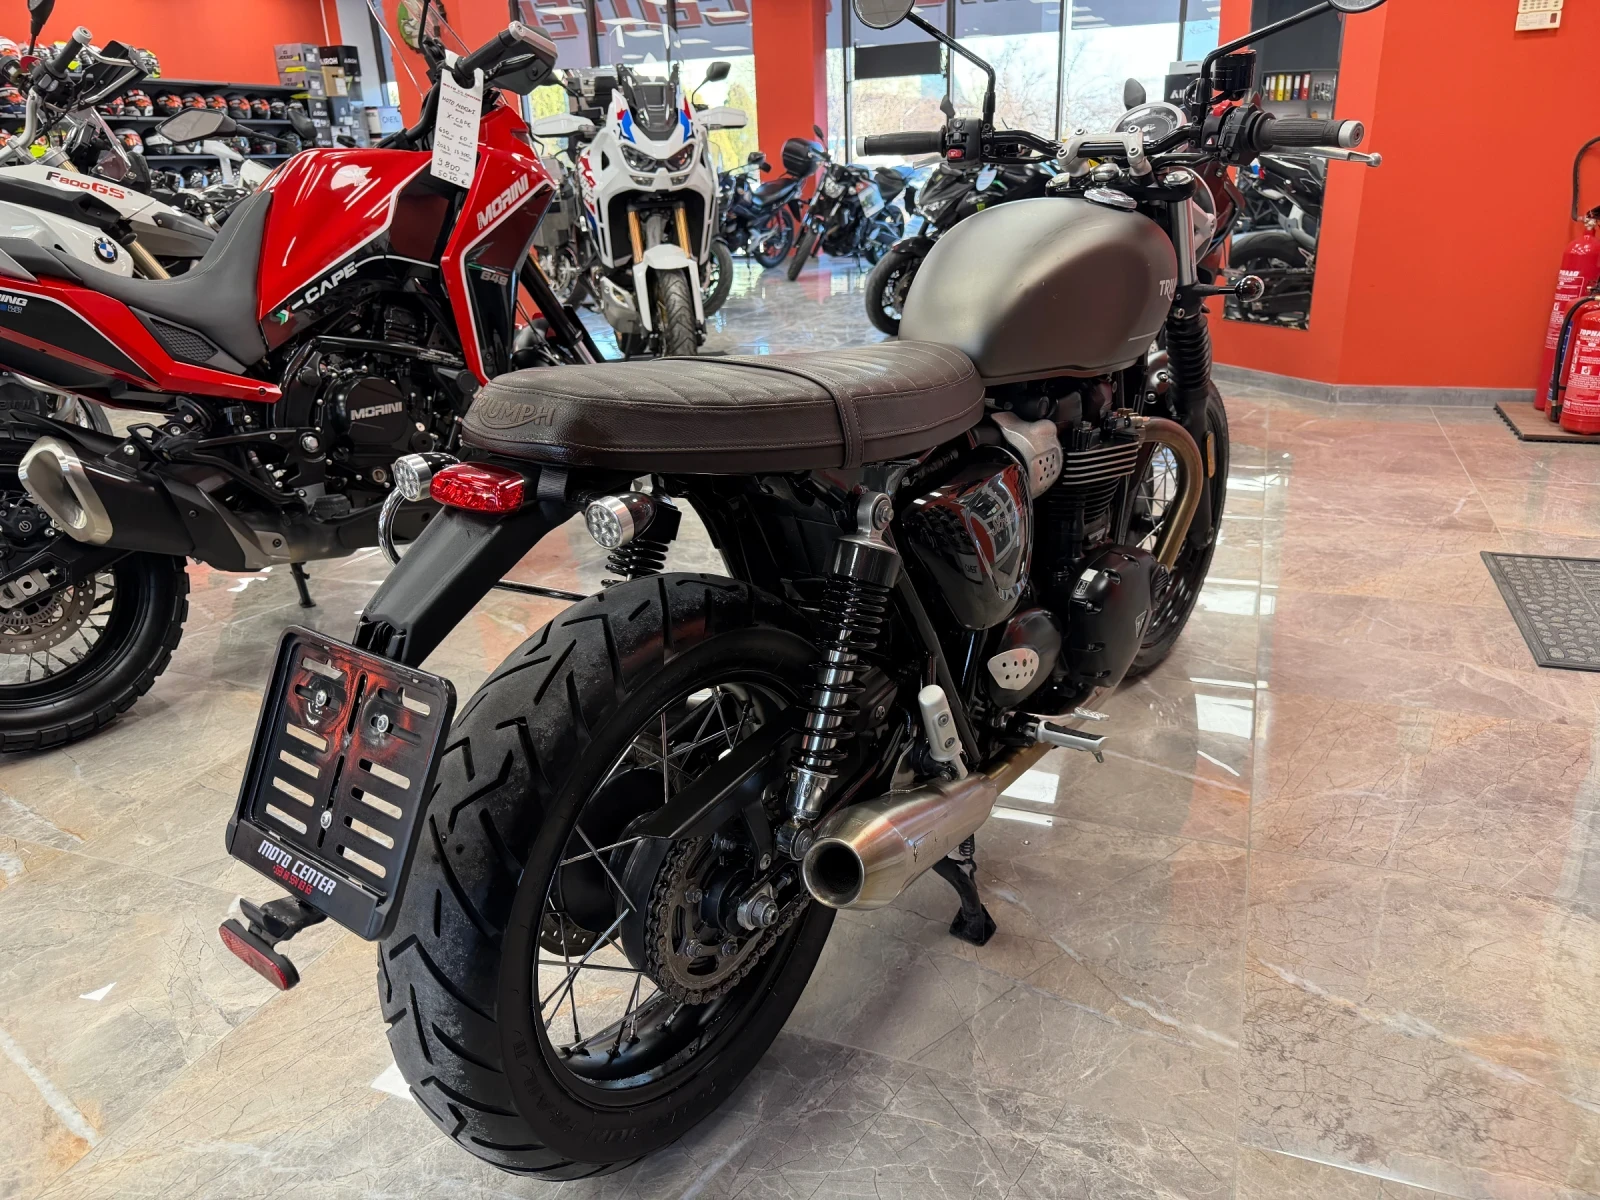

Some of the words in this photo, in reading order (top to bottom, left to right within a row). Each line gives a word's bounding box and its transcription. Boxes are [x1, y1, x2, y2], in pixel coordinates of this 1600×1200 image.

[476, 173, 530, 231] MORINI
[276, 261, 359, 326] X-CAPE
[350, 401, 403, 421] MORINI
[257, 839, 293, 869] MOTO
[291, 860, 337, 896] CENTER
